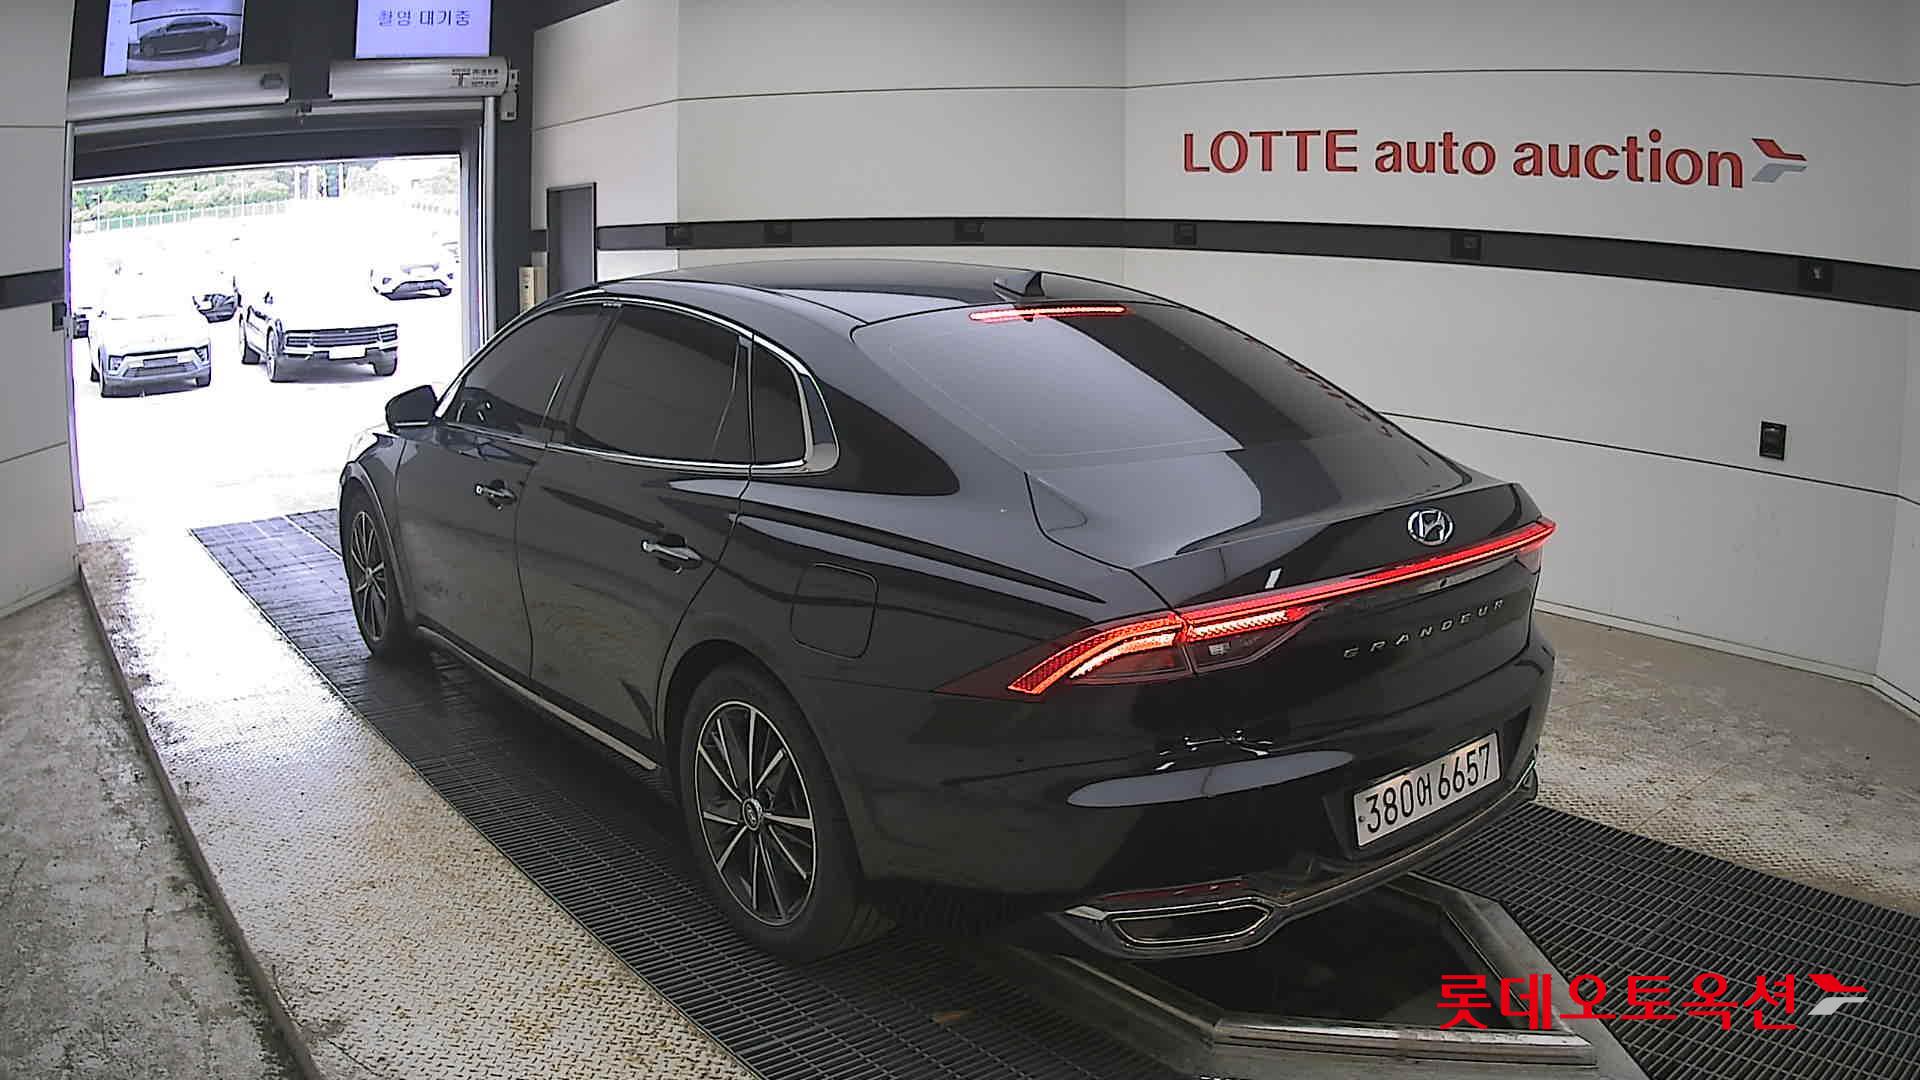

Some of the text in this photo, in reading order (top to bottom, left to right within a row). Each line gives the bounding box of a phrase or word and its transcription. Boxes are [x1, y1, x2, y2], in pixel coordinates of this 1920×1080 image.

[419, 10, 470, 26] 대기중
[1183, 128, 1744, 188] LOTTE auto auction
[1343, 599, 1504, 658] GRANDEUR
[1366, 743, 1490, 833] 380어 6657
